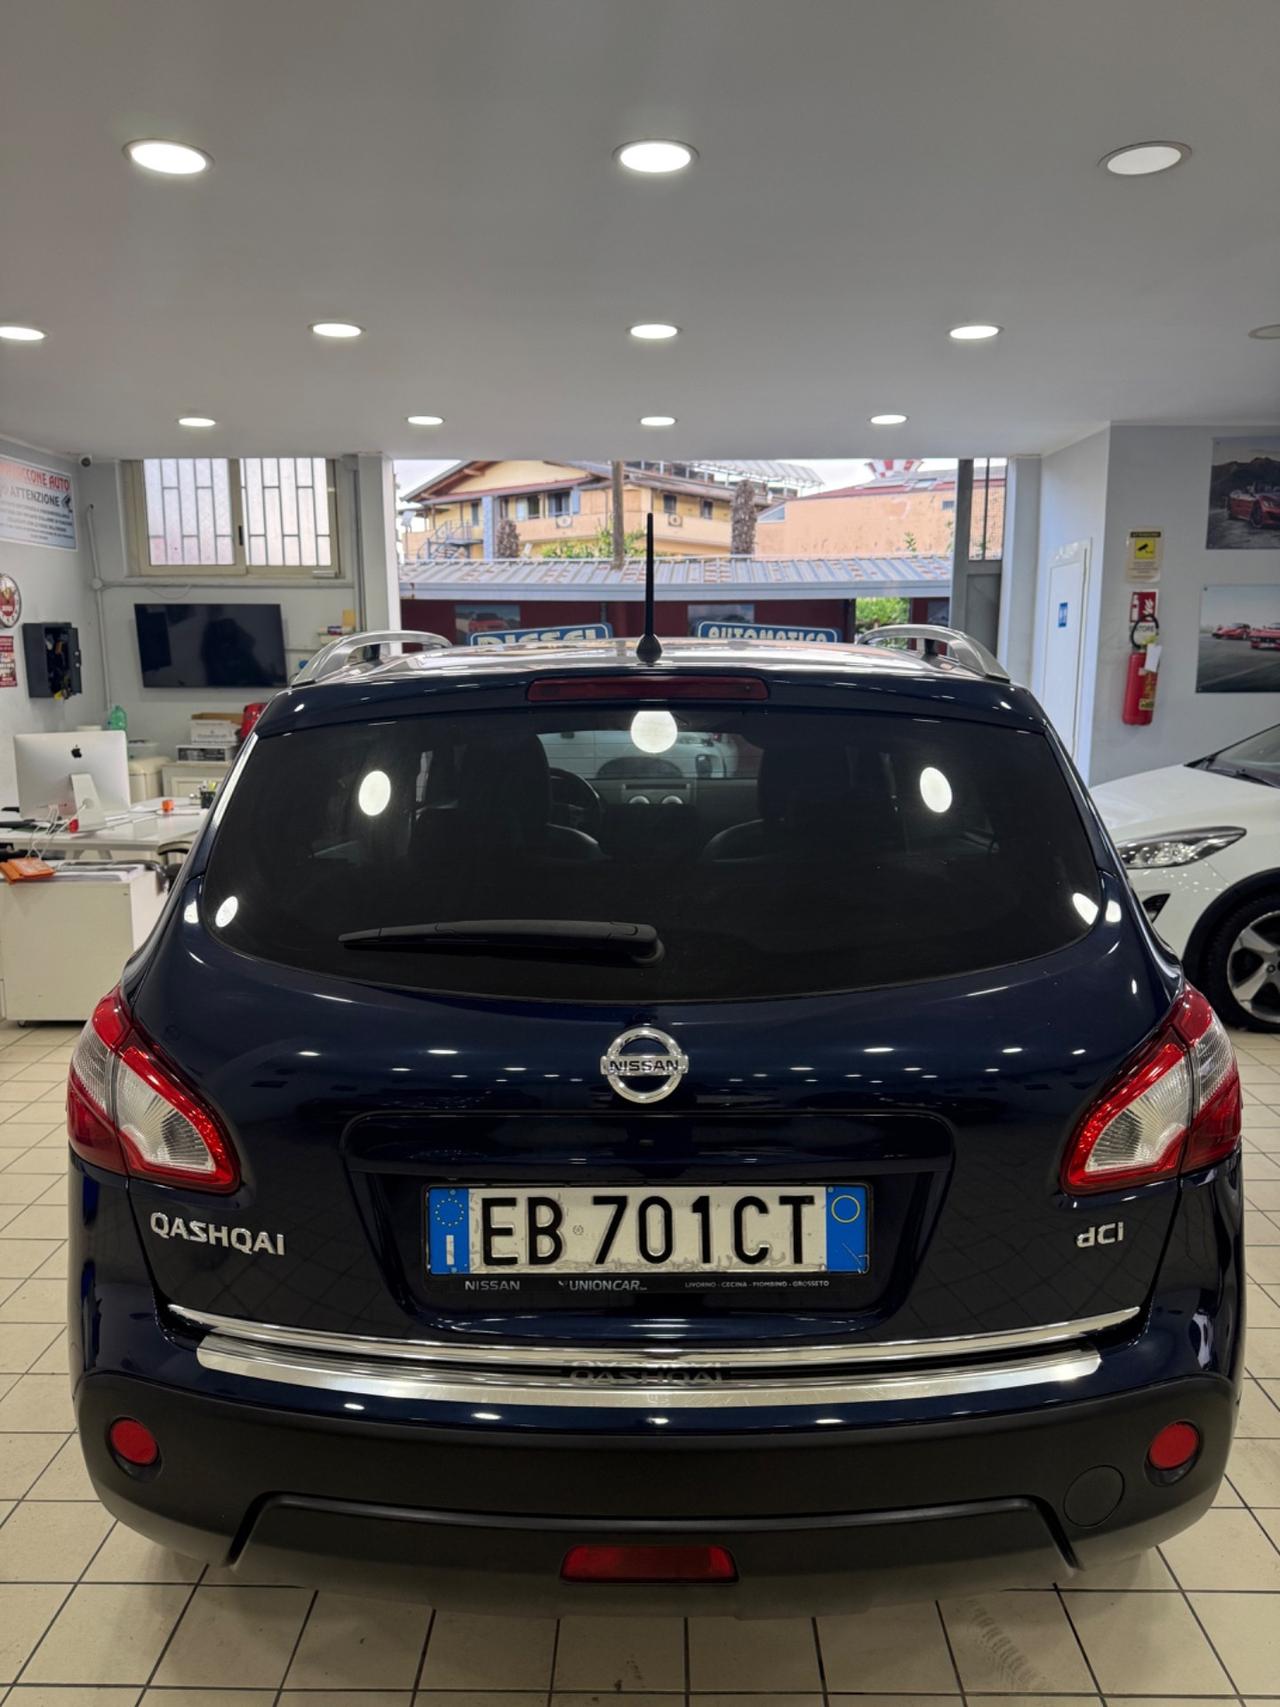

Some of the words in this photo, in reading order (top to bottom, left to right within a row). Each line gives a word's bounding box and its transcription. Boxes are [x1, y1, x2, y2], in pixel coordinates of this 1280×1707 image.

[49, 474, 71, 492] AUTO
[10, 486, 61, 507] ATTENZIONE
[609, 1060, 679, 1072] NISSAN
[150, 1211, 286, 1256] QASHQAI
[481, 1196, 564, 1266] EB
[464, 1280, 521, 1291] NISSAN
[568, 1280, 641, 1291] UNIONCAR
[792, 1280, 830, 1288] GROSSETO
